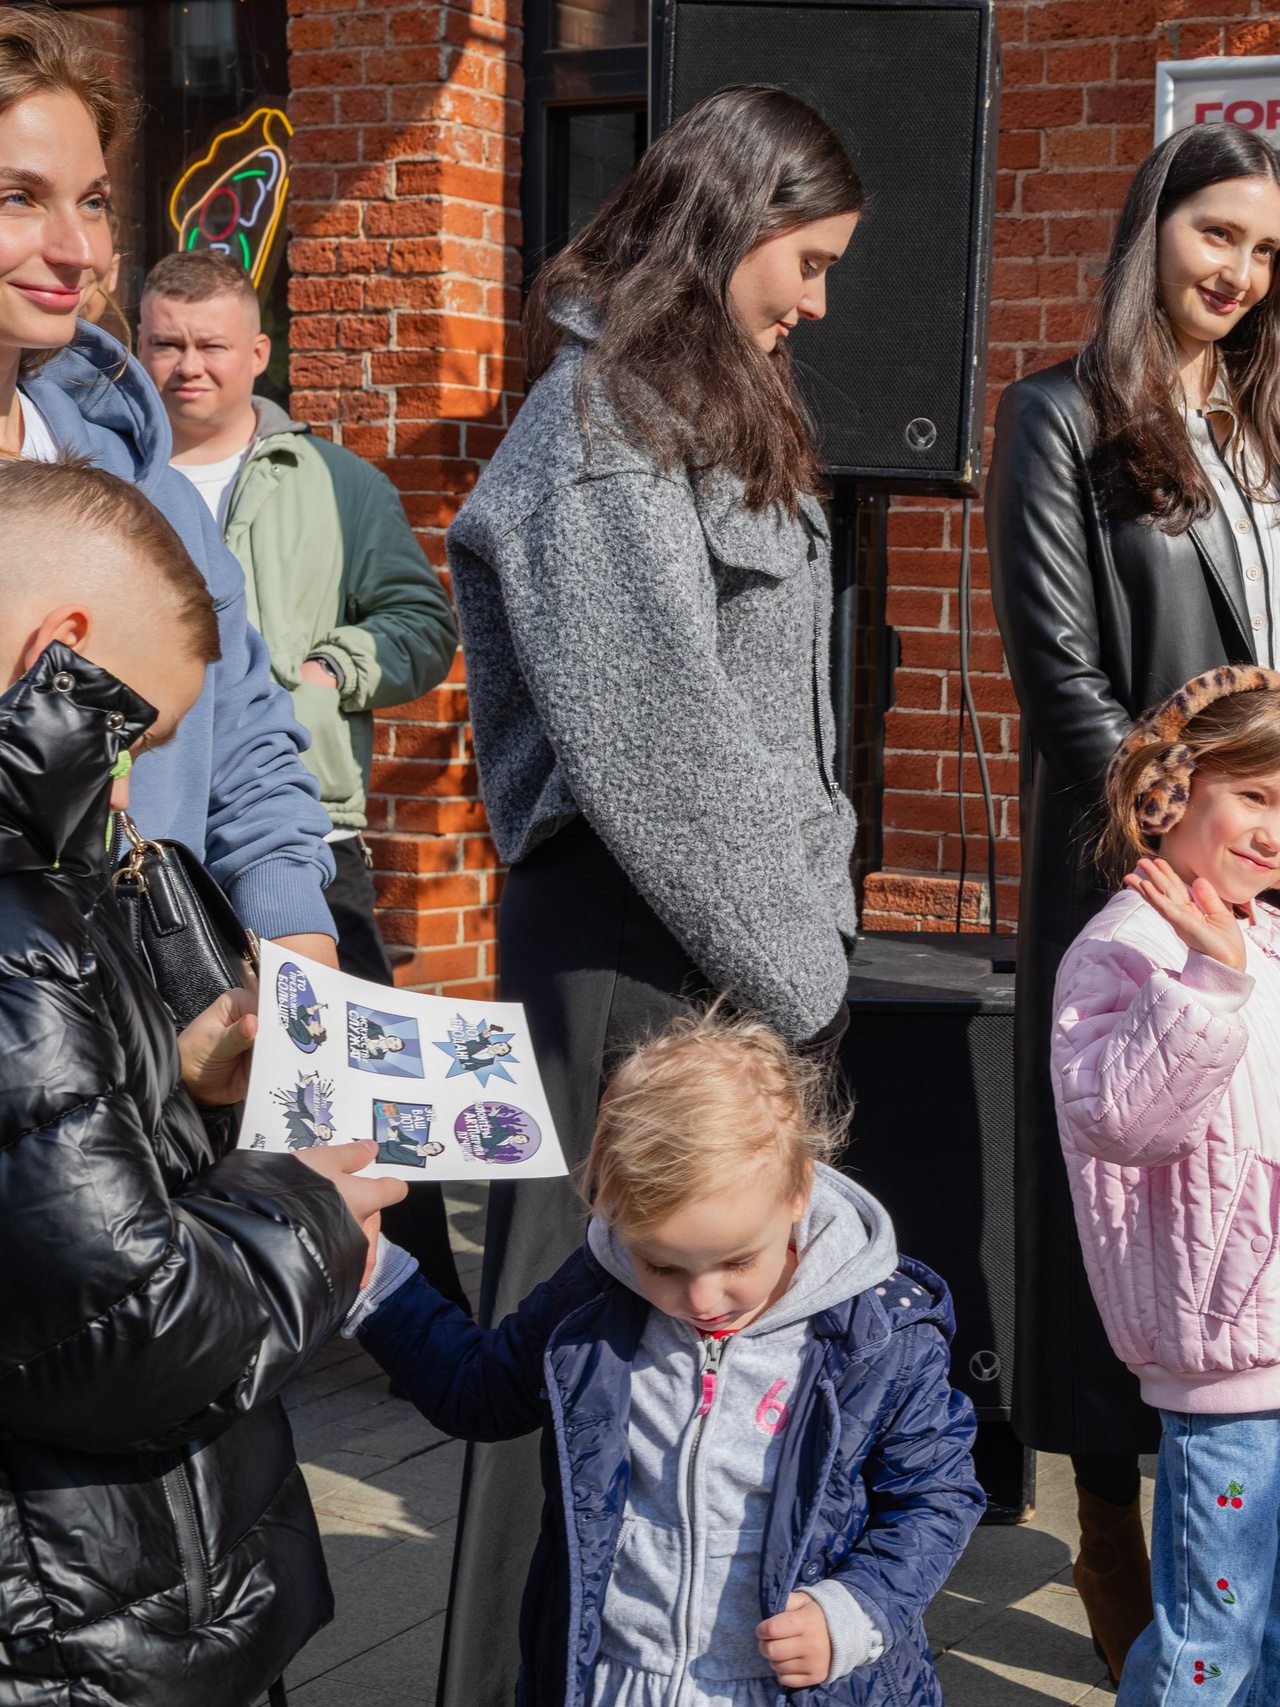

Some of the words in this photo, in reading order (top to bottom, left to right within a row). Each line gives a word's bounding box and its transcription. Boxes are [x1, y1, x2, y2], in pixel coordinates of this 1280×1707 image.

[288, 971, 298, 1021] ПРЕДЛОЖИТ
[296, 970, 307, 992] КТО
[278, 973, 290, 1029] БОЛЬШЕ?
[450, 1018, 469, 1060] ПРОДАН!
[465, 1023, 480, 1042] ЛОТ
[400, 1113, 415, 1132] ЛОТ!
[411, 1109, 427, 1129] ВАШ
[754, 1377, 789, 1436] 6
